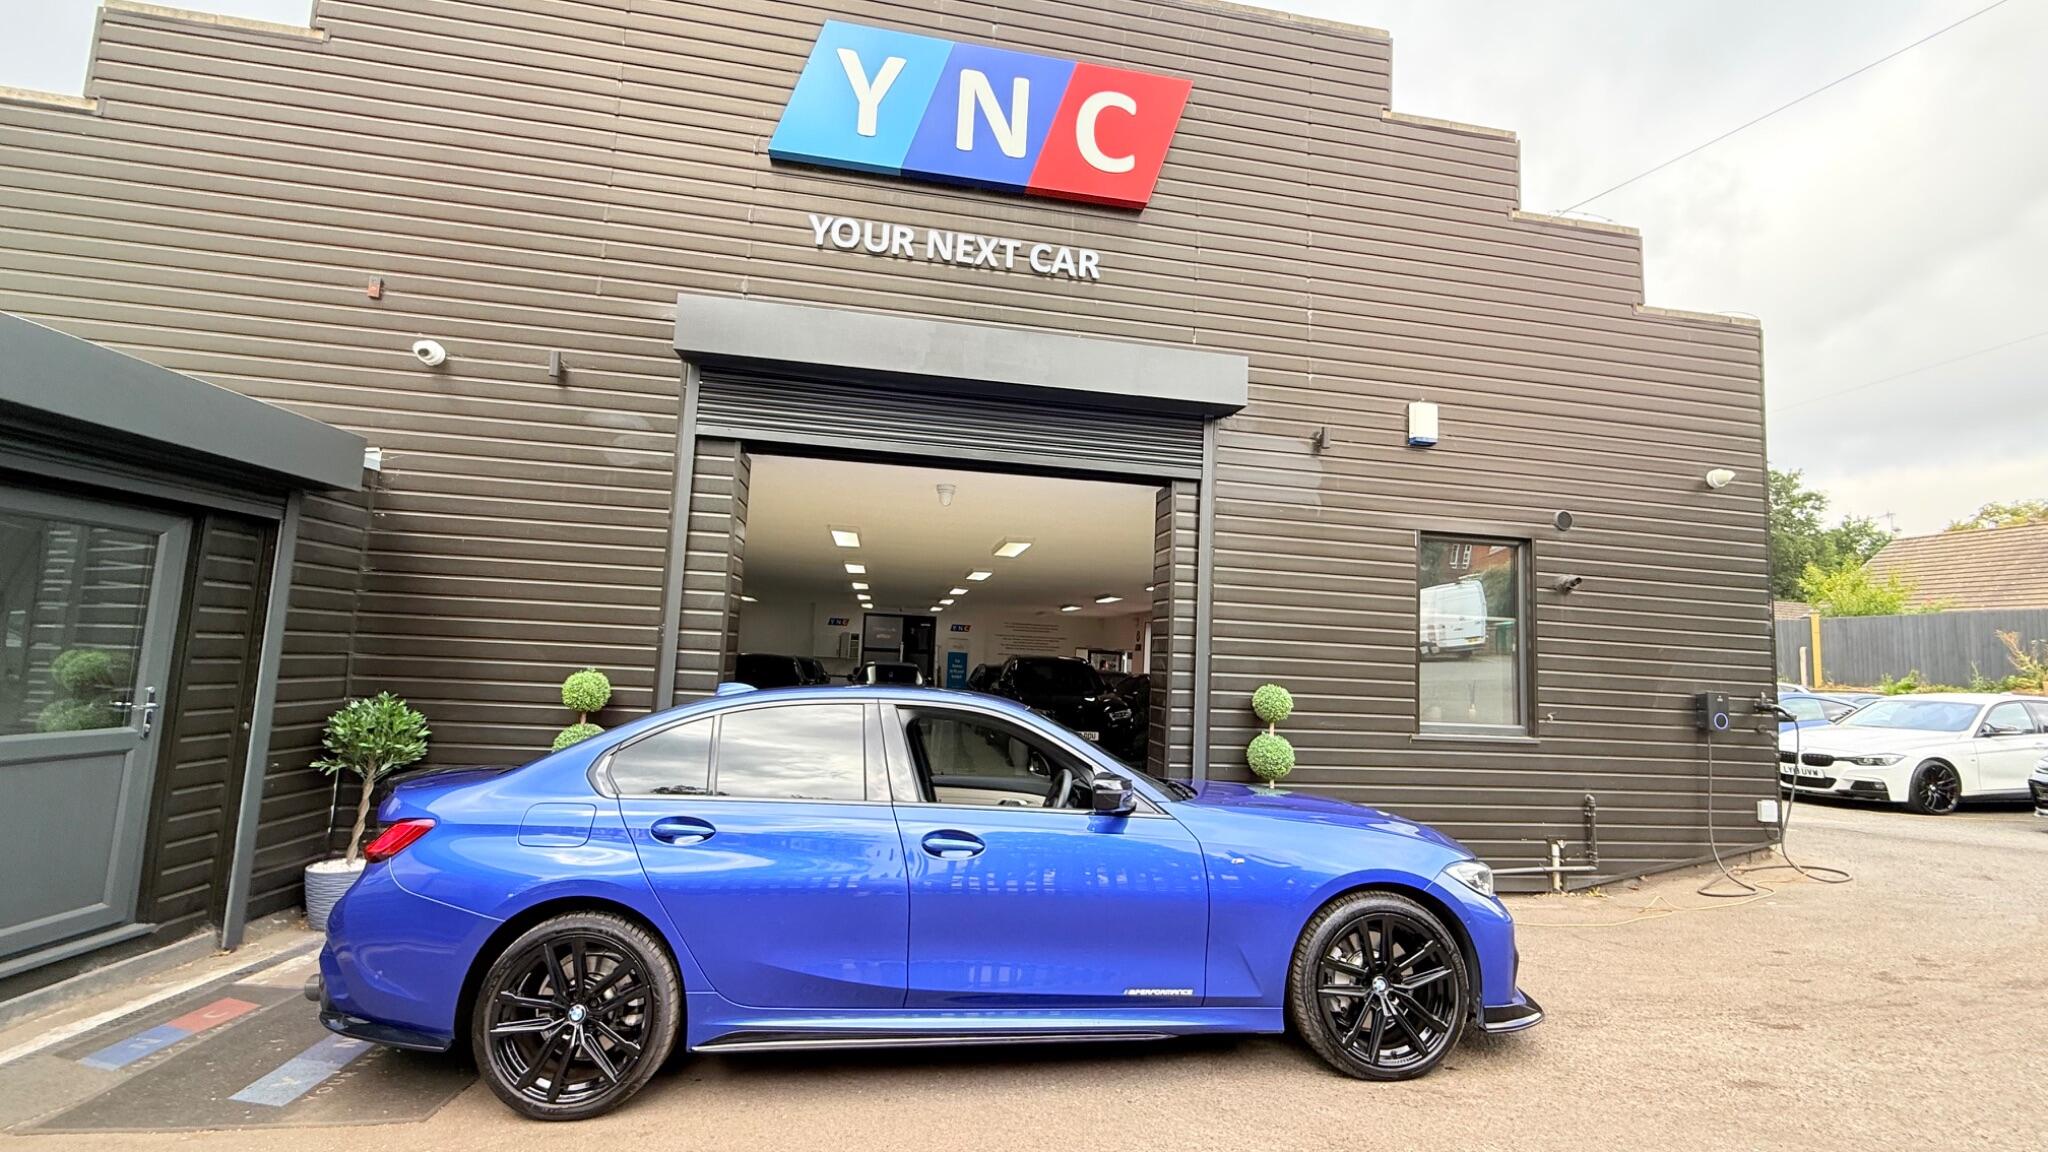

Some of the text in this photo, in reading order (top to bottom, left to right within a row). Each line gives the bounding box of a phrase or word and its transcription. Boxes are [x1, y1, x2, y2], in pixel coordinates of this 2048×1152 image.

[836, 47, 1137, 173] YNC
[808, 213, 1100, 281] YOUR NEXT CAR
